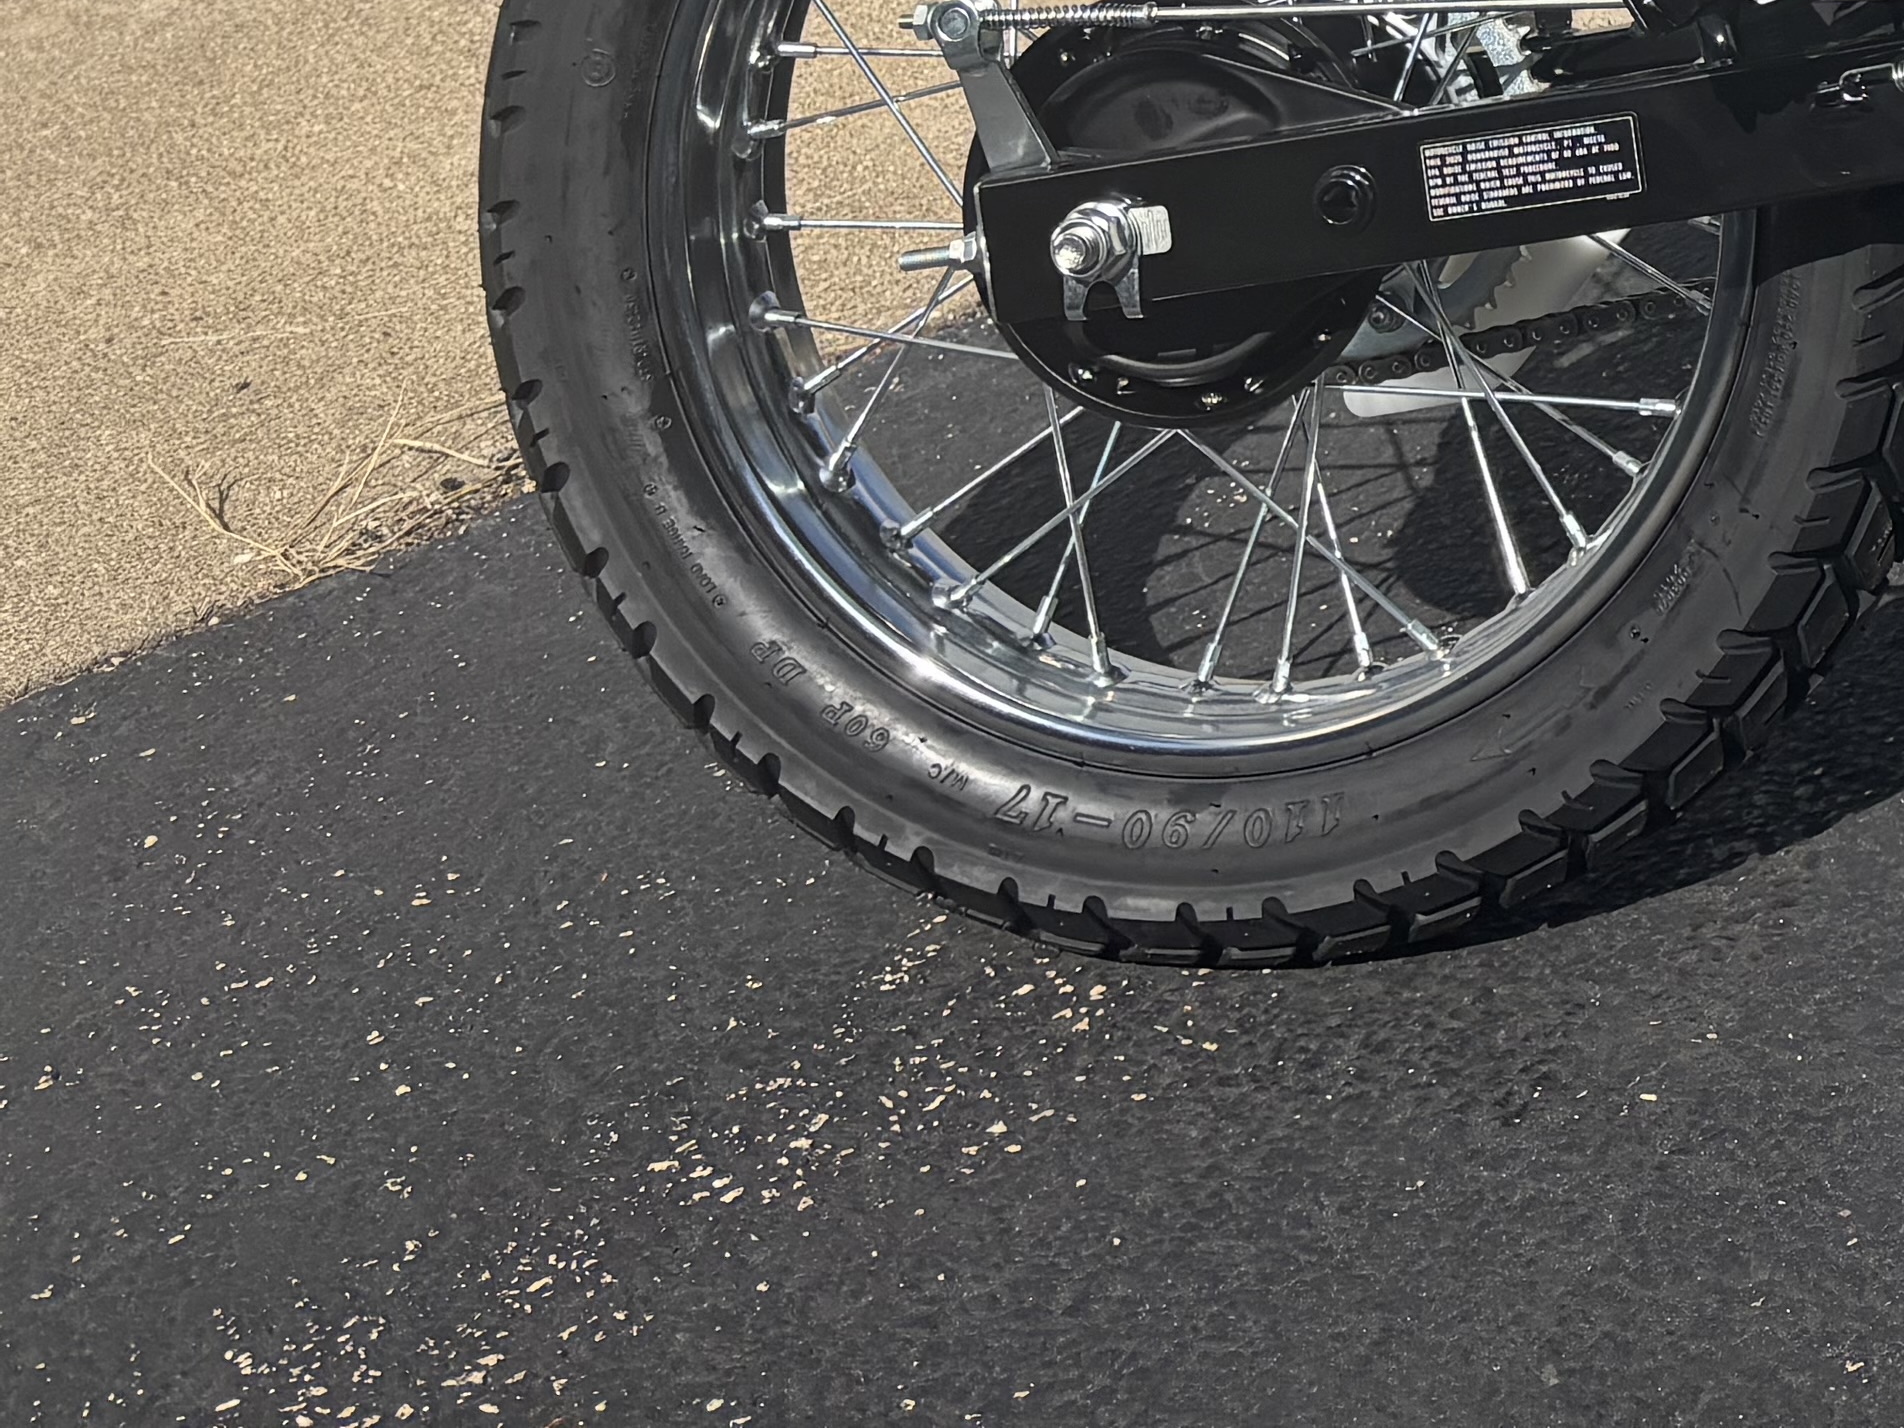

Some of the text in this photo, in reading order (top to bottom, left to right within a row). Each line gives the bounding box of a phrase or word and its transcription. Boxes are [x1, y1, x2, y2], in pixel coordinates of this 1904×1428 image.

[747, 629, 1351, 850] 110/90-17 M/C 60P DP
